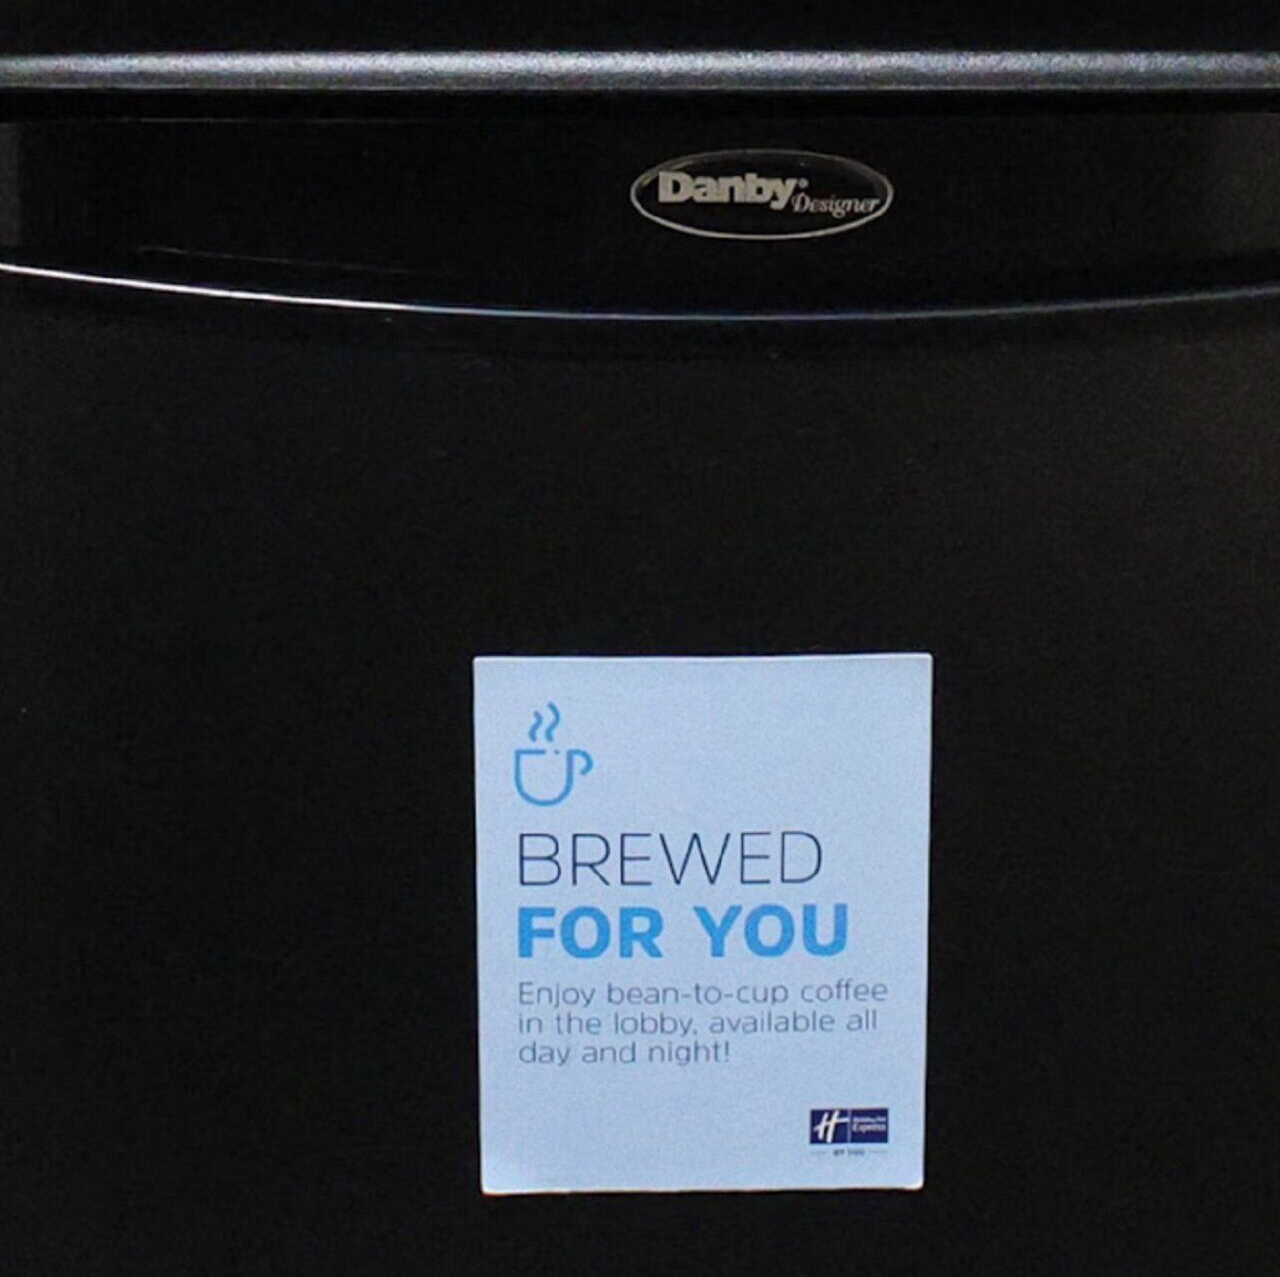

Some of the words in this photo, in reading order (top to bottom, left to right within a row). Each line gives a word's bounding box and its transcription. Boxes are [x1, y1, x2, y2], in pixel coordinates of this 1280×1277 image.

[658, 171, 797, 210] Danby
[792, 191, 880, 218] Designer
[519, 831, 822, 886] BREWED
[517, 906, 663, 958] FOR
[693, 903, 849, 958] YOU
[519, 981, 596, 1007] Enjoy
[607, 981, 790, 1005] bean-to-cup
[801, 979, 888, 1002] coffee
[519, 1014, 544, 1034] in
[555, 1013, 601, 1034] the
[614, 1012, 699, 1037] lobby,
[709, 1011, 835, 1033] available
[846, 1011, 877, 1031] all
[519, 1042, 571, 1067] day
[581, 1042, 636, 1063] and
[648, 1041, 730, 1066] night!
